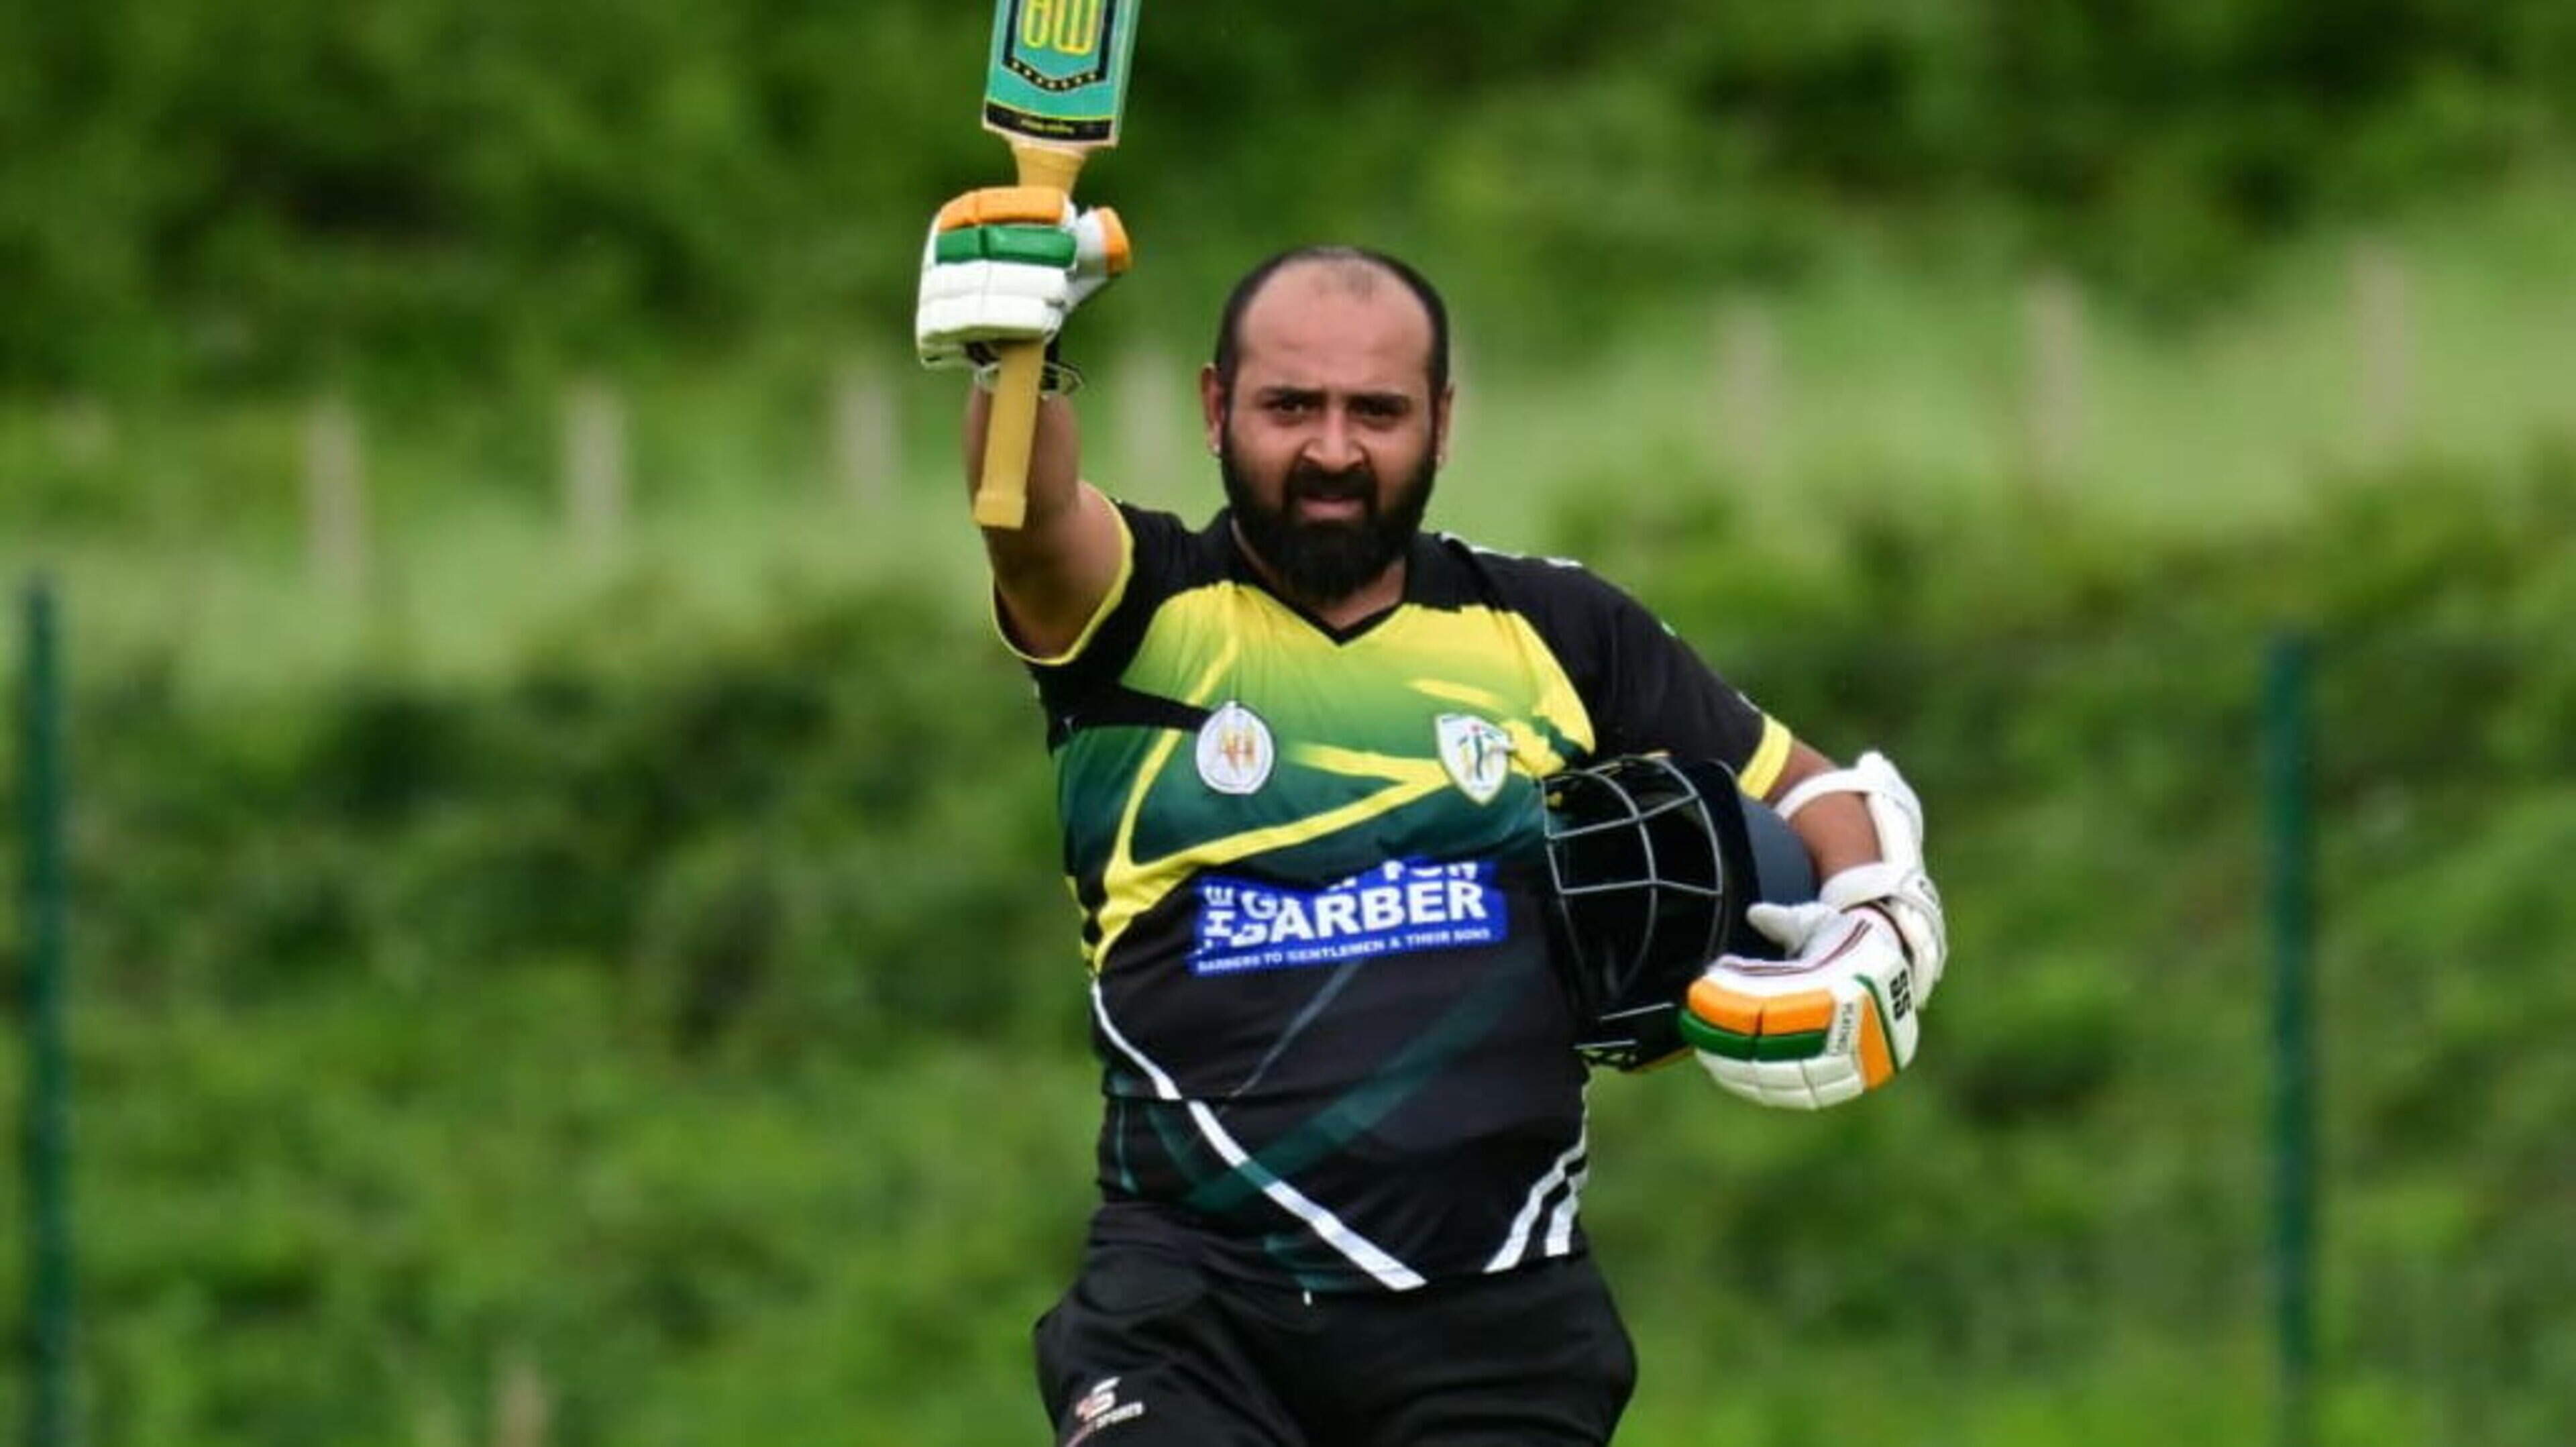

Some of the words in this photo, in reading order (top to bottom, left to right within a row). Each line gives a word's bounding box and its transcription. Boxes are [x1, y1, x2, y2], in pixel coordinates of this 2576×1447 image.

[1195, 886, 1235, 955] HE
[1264, 951, 1283, 965] TO
[1287, 940, 1385, 962] GENTLEMEN
[1406, 930, 1450, 947] THEIR
[1454, 927, 1491, 941] SONS
